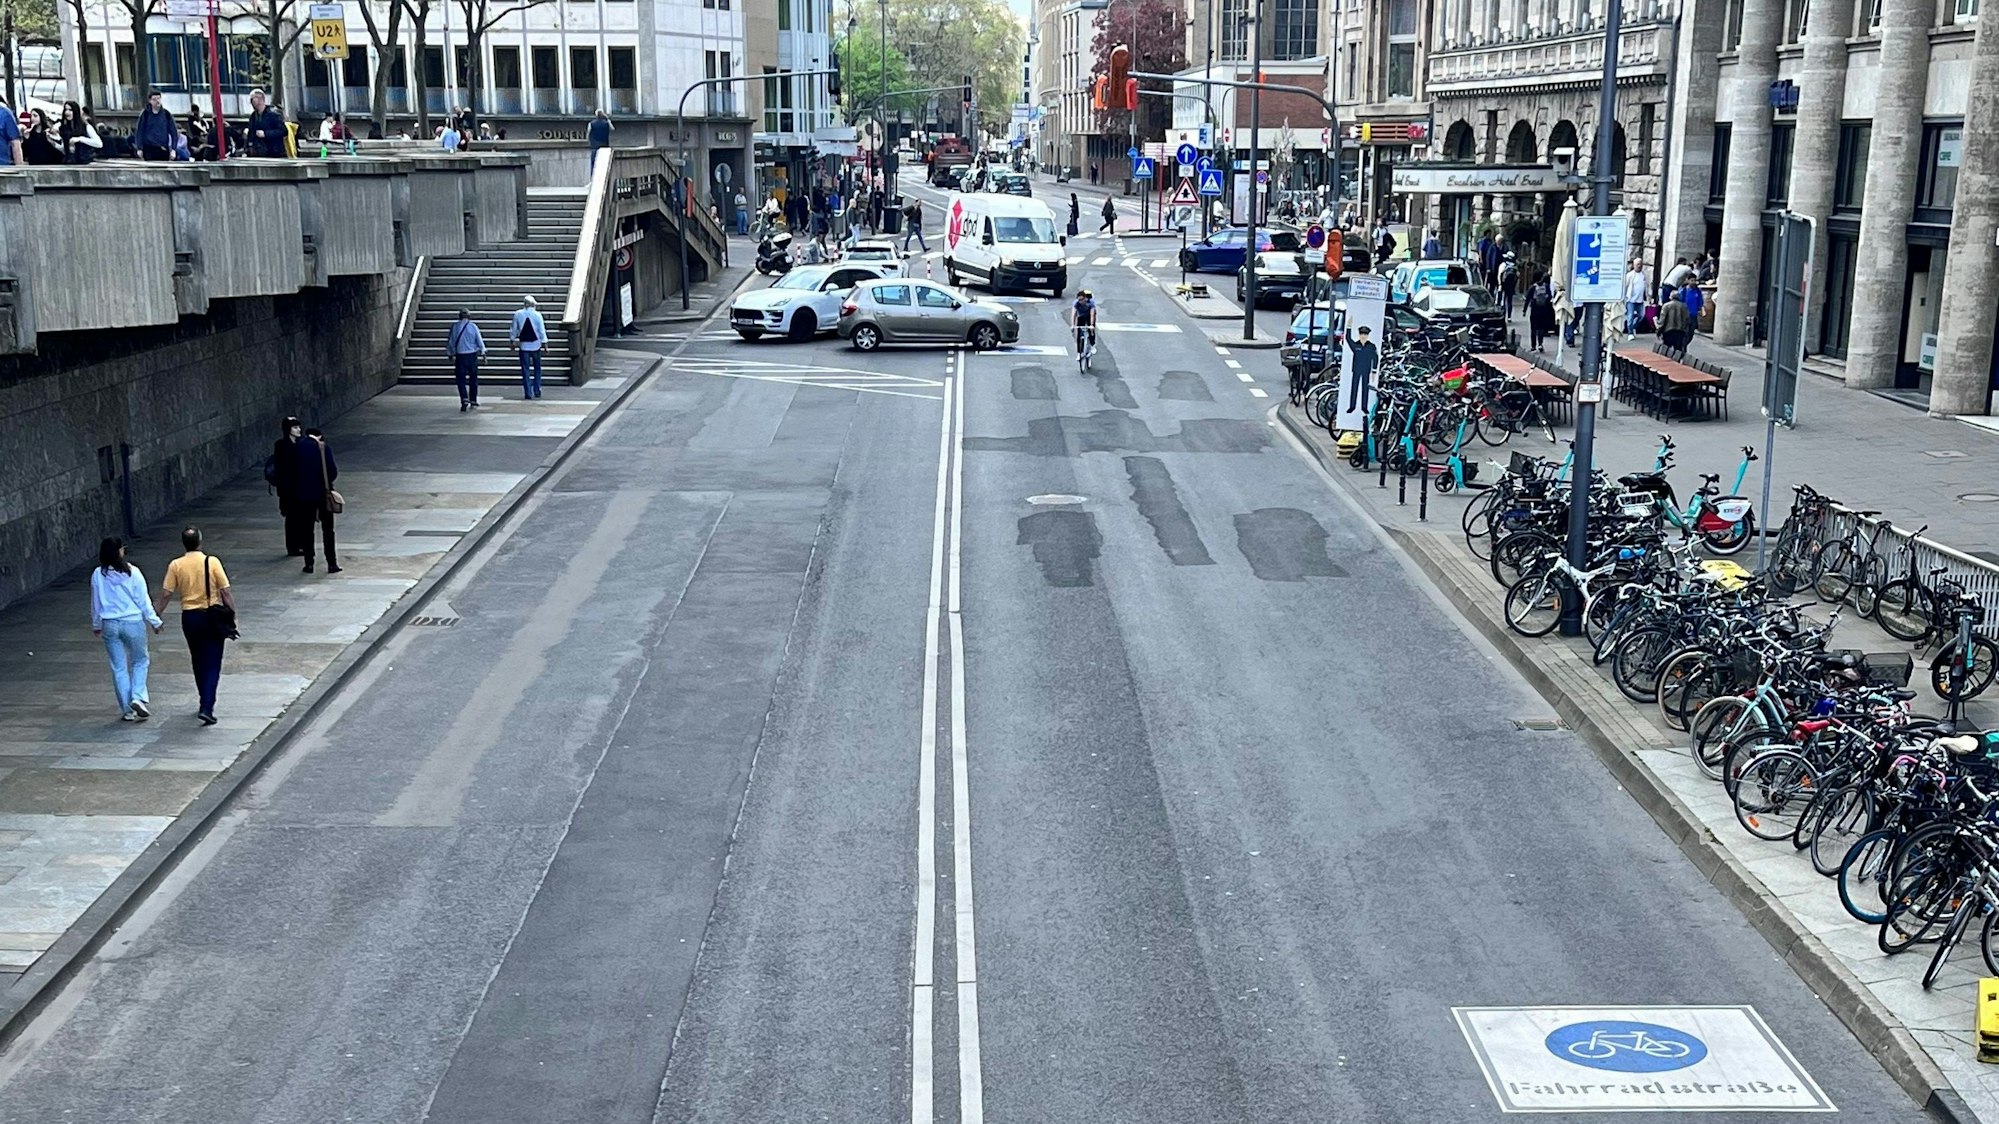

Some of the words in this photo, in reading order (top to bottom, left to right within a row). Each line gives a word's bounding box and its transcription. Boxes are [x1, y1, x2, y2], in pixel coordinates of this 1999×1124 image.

[316, 25, 334, 38] U2
[537, 129, 586, 140] SOUVEN
[1446, 174, 1485, 187] Excelsior
[1488, 172, 1519, 187] Hotel
[1520, 174, 1544, 187] Ernst
[963, 211, 979, 240] dpd
